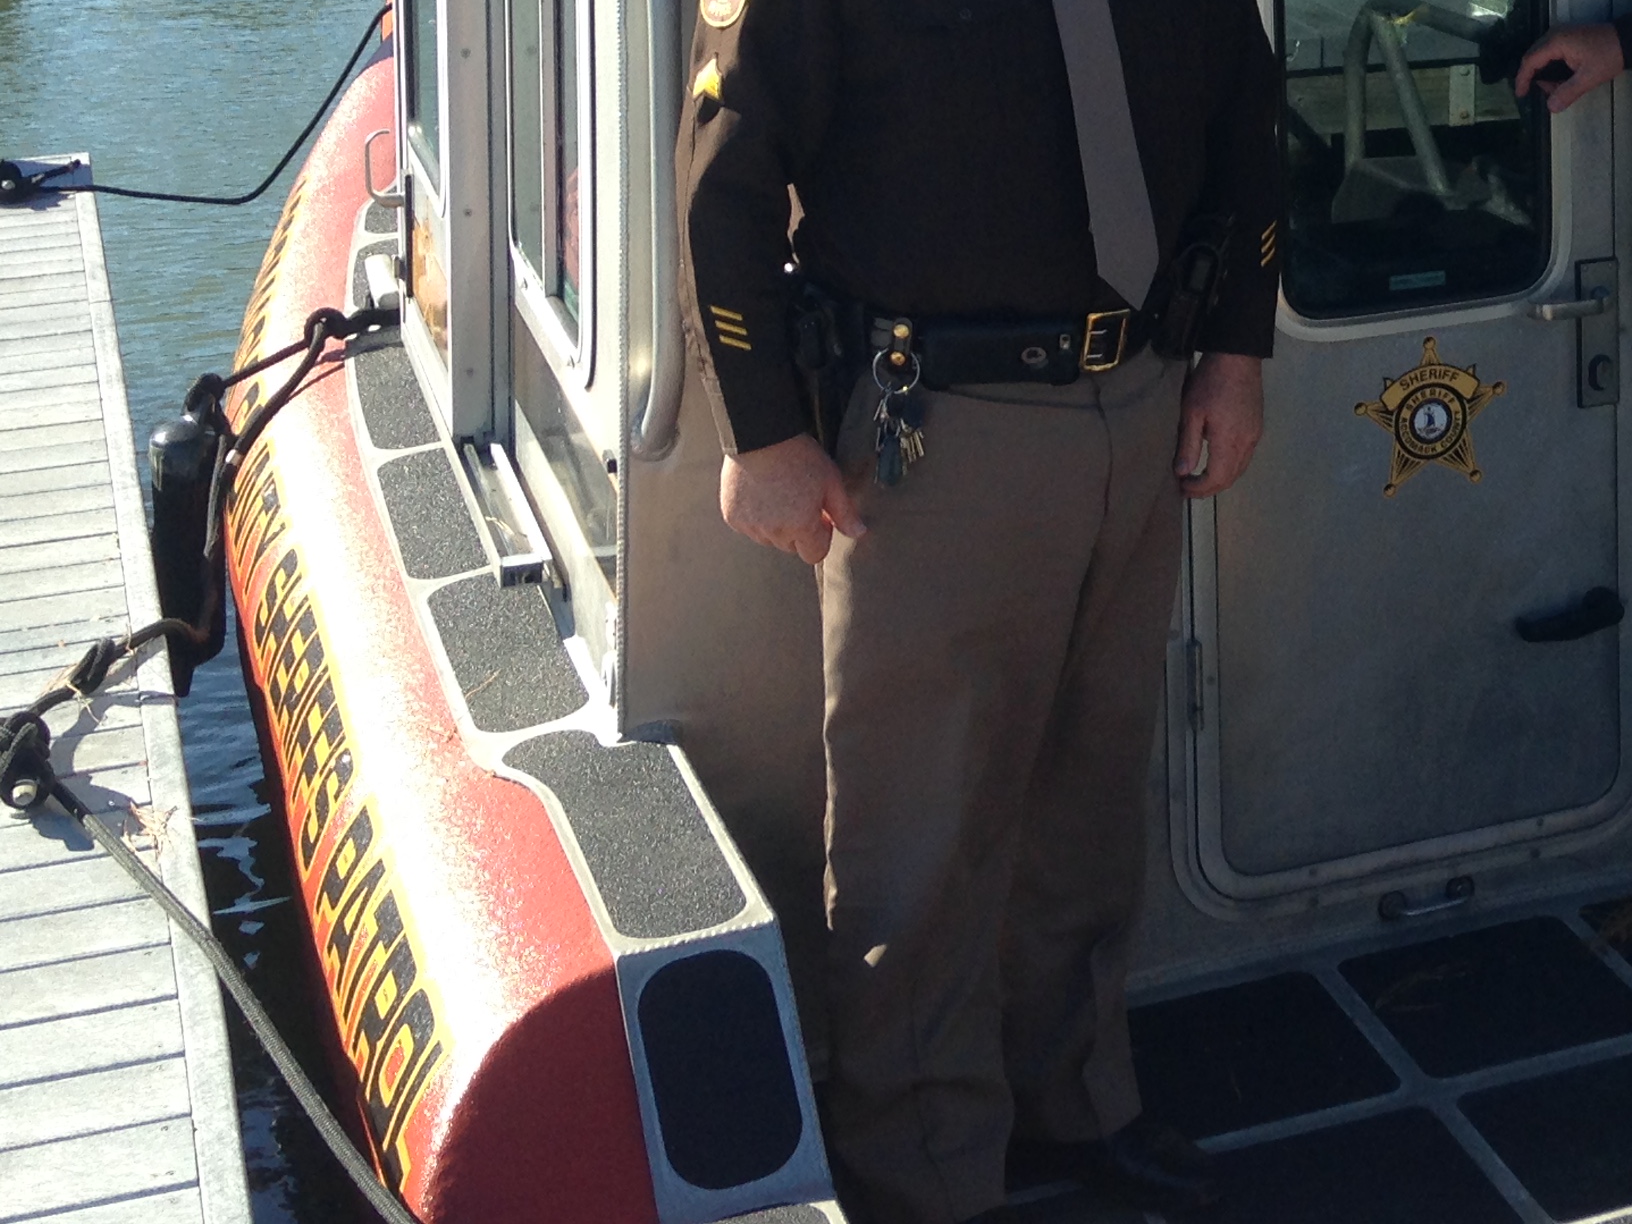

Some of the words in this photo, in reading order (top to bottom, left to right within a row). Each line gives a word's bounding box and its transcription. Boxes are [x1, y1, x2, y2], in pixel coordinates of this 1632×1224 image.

[1399, 368, 1460, 392] SHERIFF
[1405, 387, 1457, 411] SHERIFF
[315, 805, 444, 1195] PATROL
